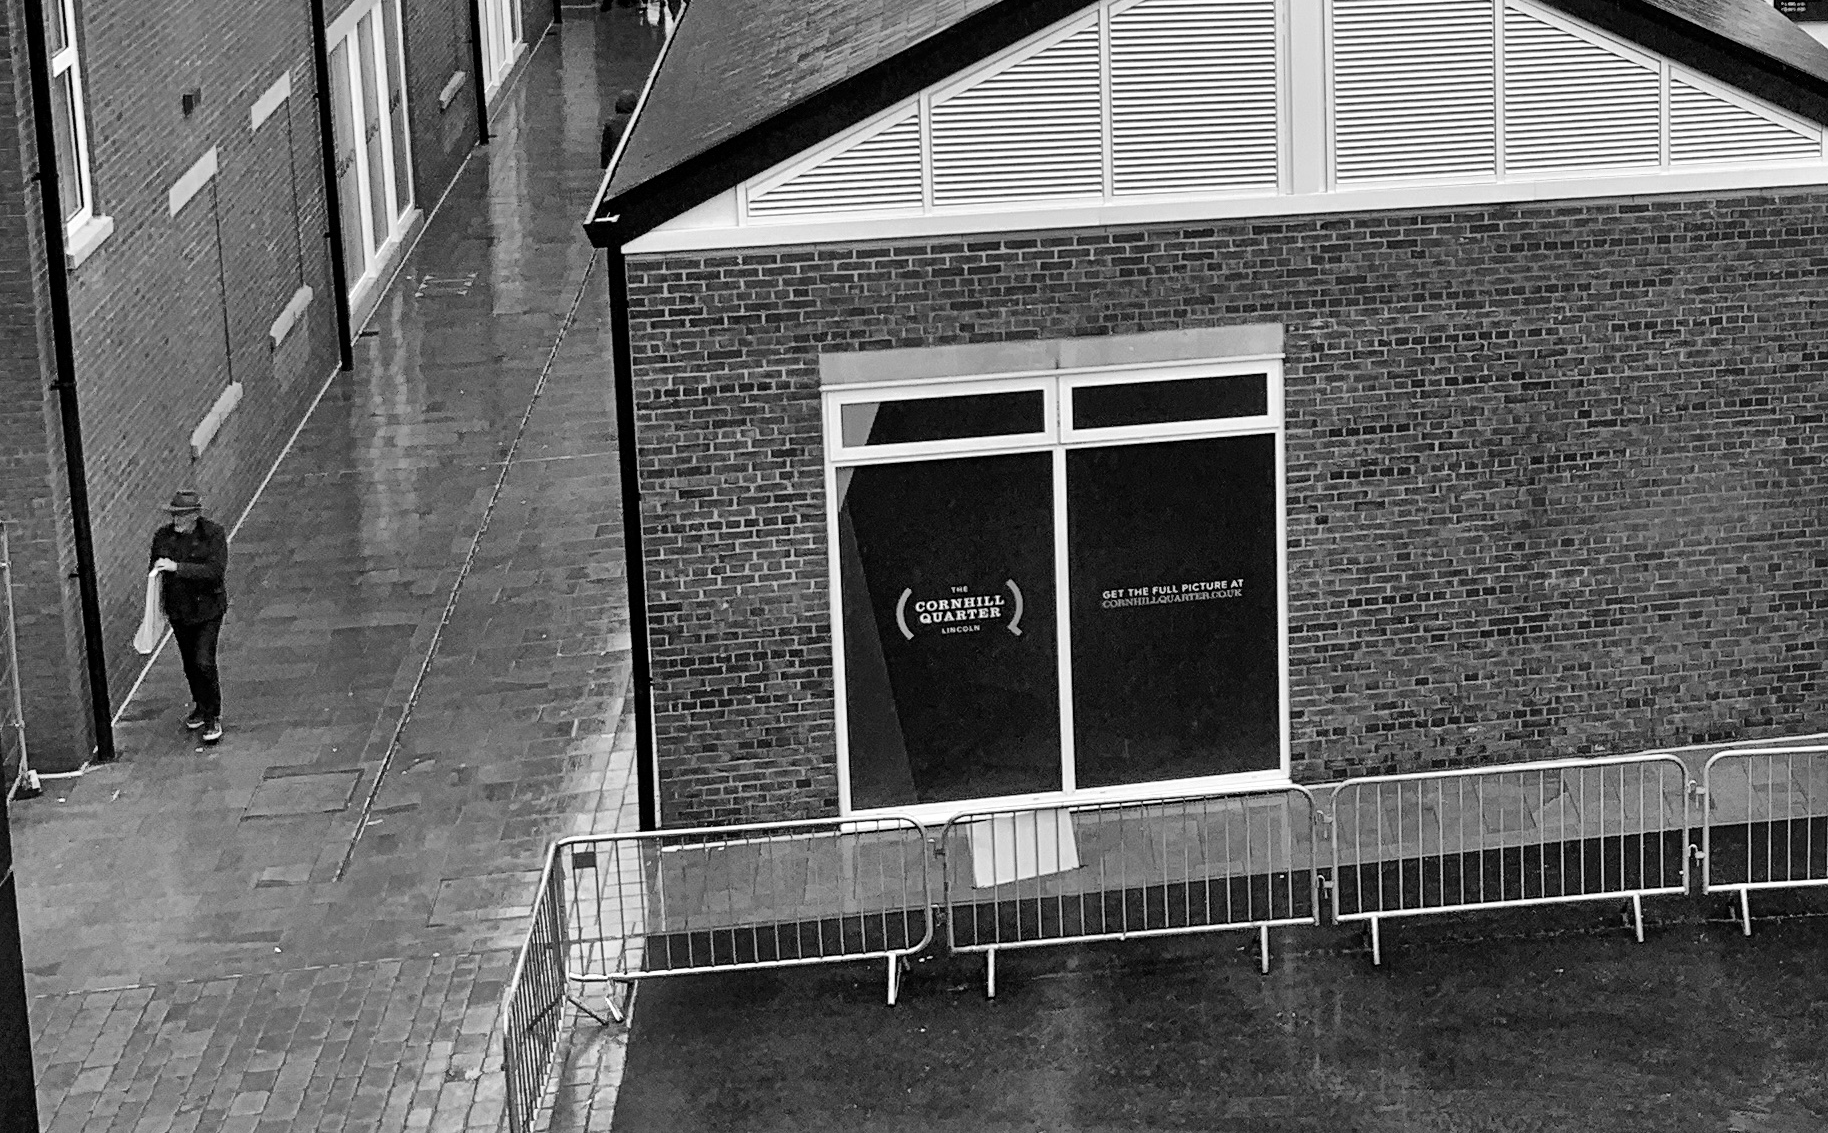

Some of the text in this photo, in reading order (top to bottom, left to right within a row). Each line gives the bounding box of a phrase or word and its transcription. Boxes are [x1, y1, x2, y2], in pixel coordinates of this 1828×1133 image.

[951, 585, 968, 594] THE
[1102, 578, 1244, 600] GET THE FULL PICTURE AT
[915, 594, 1005, 613] CORNHILL
[919, 606, 1002, 624] QUARTER
[941, 624, 981, 635] LINCOLN
